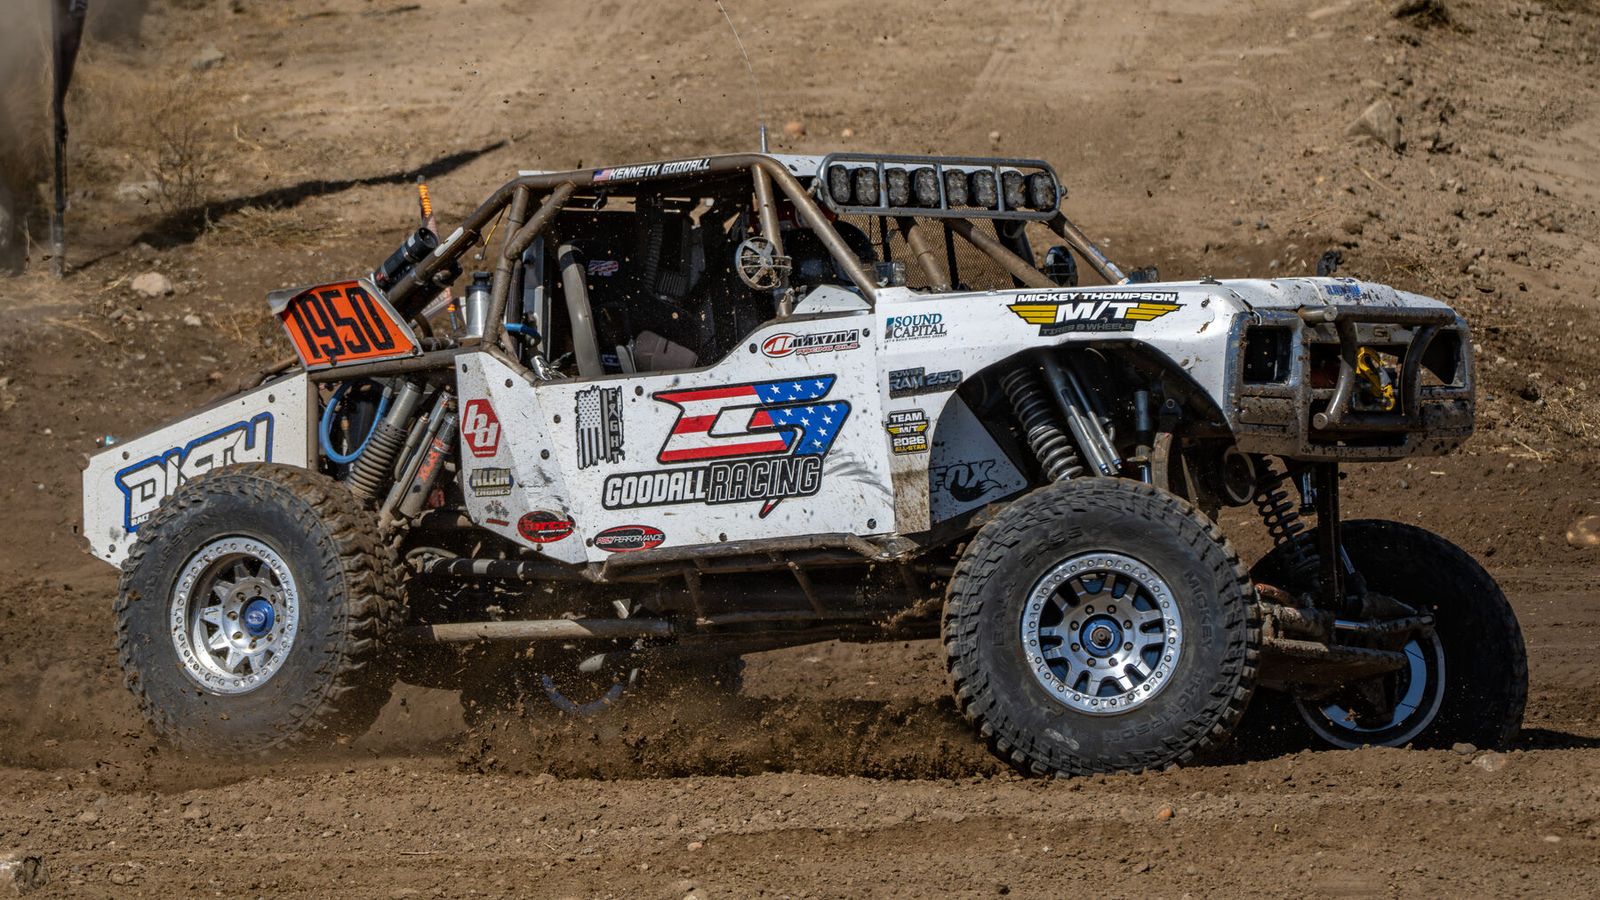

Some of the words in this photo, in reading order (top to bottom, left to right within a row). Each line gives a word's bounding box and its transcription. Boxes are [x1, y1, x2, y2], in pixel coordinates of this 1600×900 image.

[608, 164, 660, 180] KENNETH
[661, 158, 711, 175] GOODALL
[1017, 292, 1079, 302] MICKEY
[1081, 292, 1176, 302] THOMPSON
[1055, 301, 1140, 323] M/T
[287, 286, 396, 359] 1950
[895, 313, 943, 328] SOUND
[893, 323, 947, 339] CAPITAL
[1041, 324, 1075, 336] TIRES
[1086, 322, 1135, 332] WHEELS
[889, 368, 924, 378] POWER
[889, 375, 923, 391] RAM
[926, 370, 961, 386] 250
[890, 411, 923, 423] TEAM
[899, 424, 919, 433] M/T
[893, 435, 926, 447] 2026
[472, 469, 510, 487] KLEIN
[605, 470, 706, 507] GOODALL
[708, 456, 822, 502] RACING
[928, 459, 998, 496] FOX
[475, 487, 511, 497] ENGINES
[614, 533, 664, 544] PERFORMANCE
